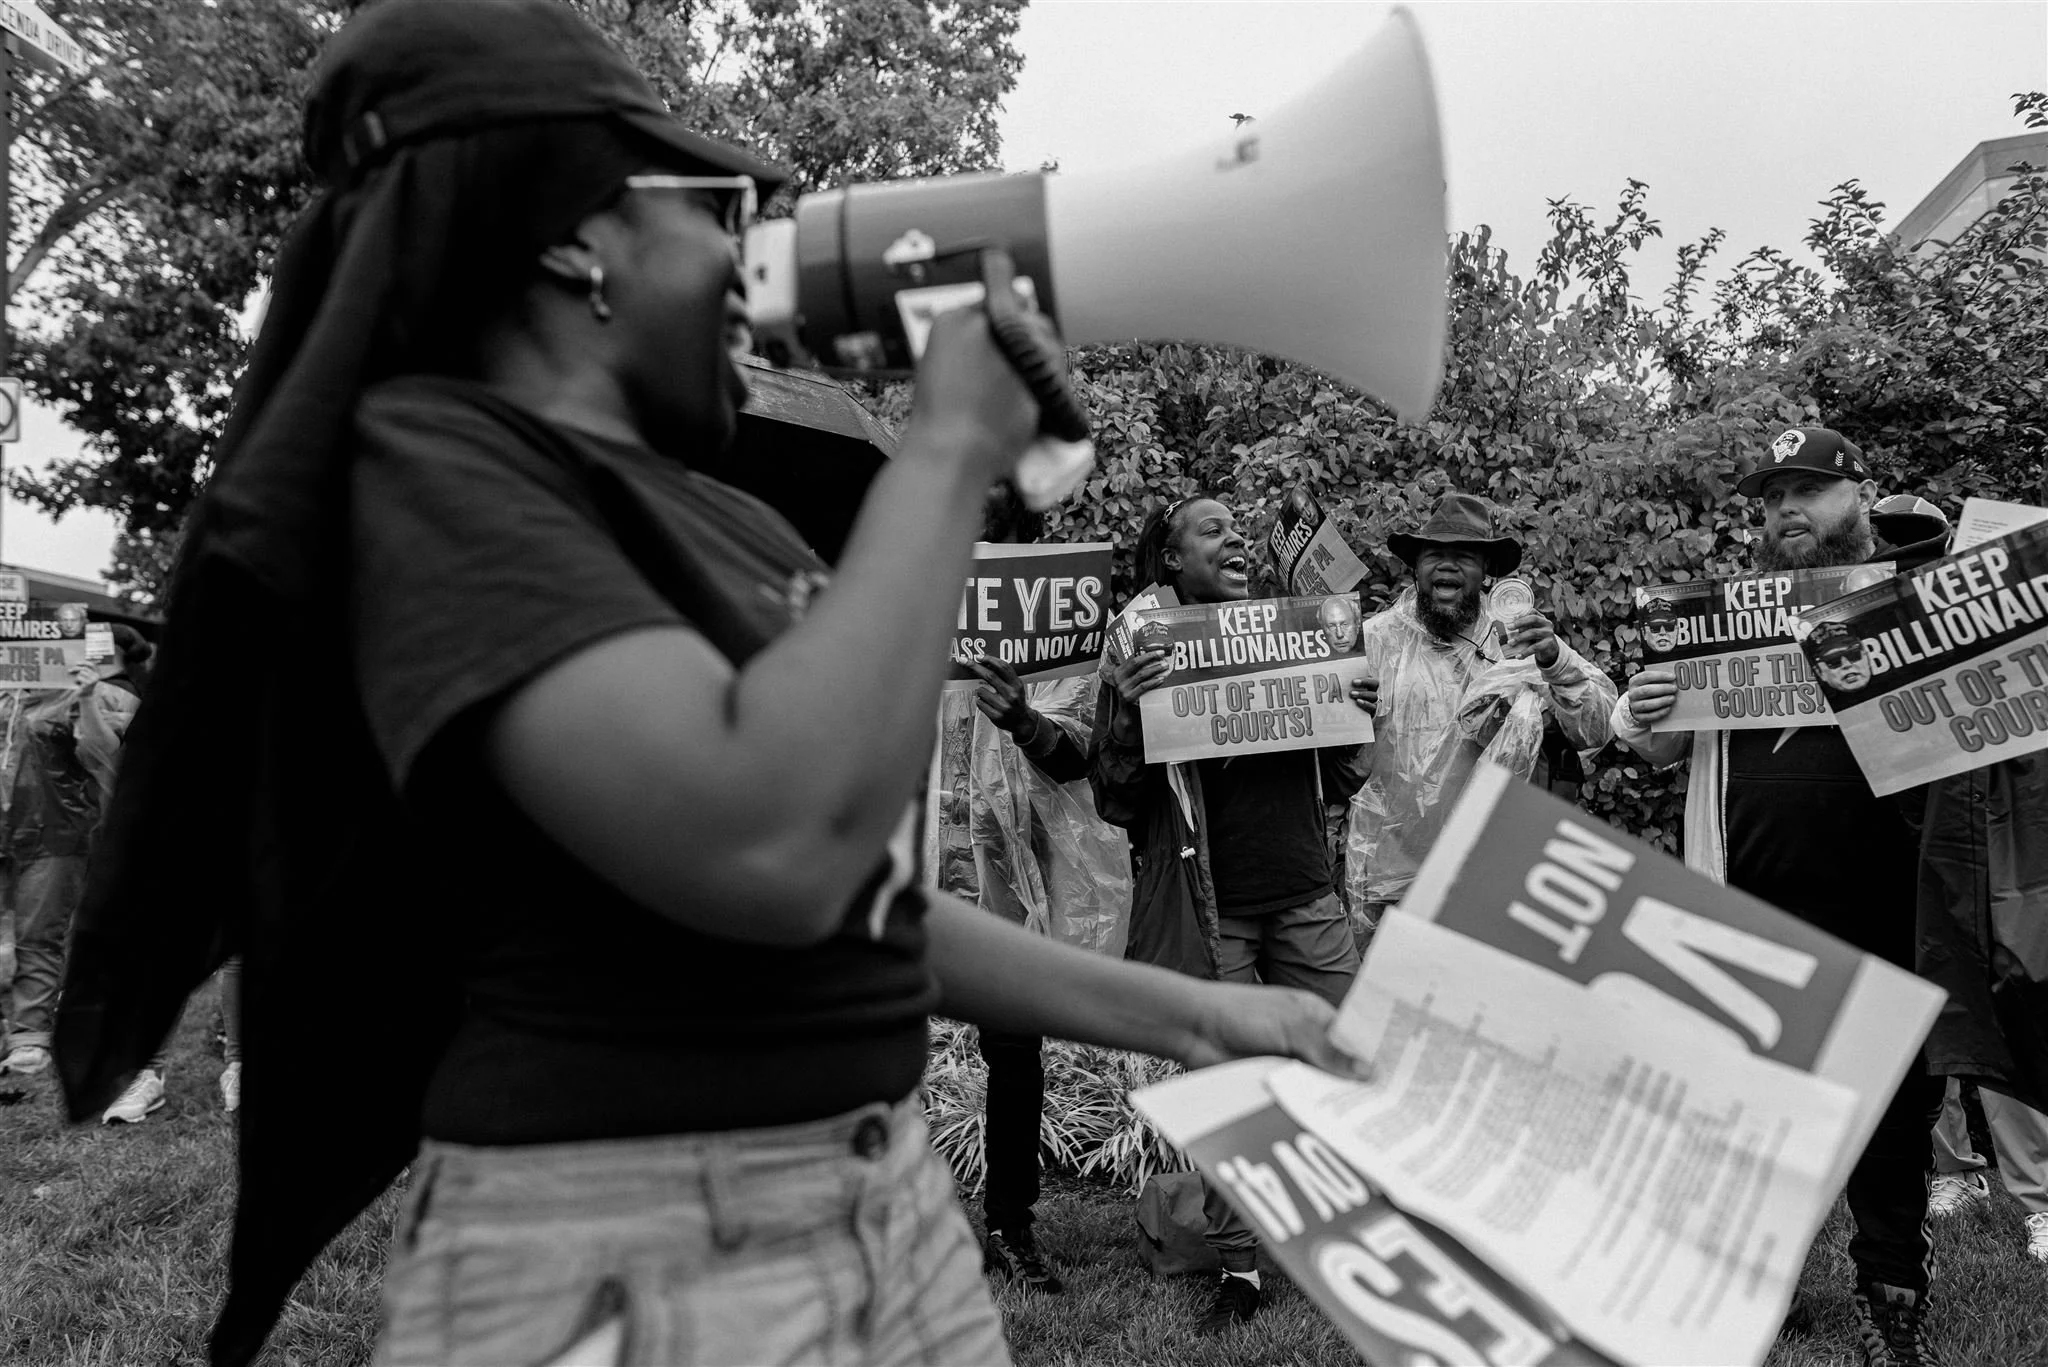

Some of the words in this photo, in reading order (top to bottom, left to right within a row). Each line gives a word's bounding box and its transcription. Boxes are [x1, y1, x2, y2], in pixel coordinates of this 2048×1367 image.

[1297, 557, 1321, 593] THE
[1312, 543, 1335, 571] PA
[1911, 547, 2009, 614] KEEP
[0, 602, 28, 620] EEP
[957, 577, 1002, 631] TE
[1013, 576, 1103, 633] YES
[1724, 576, 1793, 612] KEEP
[0, 620, 62, 639] NAIRES
[1217, 604, 1277, 637] KEEP
[949, 637, 987, 664] ASS
[999, 638, 1029, 664] ON
[1035, 633, 1078, 662] NOV
[1080, 631, 1101, 654] 4!
[1174, 629, 1331, 672] BILLIONAIRES
[1674, 658, 1722, 691] OUT
[1727, 655, 1761, 688] OF
[1171, 683, 1219, 718] OUT
[1225, 680, 1255, 713] OF
[1259, 675, 1310, 709] THE
[1312, 672, 1344, 704] PA
[1712, 683, 1826, 719] COURTS!
[1879, 678, 1954, 733] OUT
[1955, 659, 2007, 707] OF
[1210, 706, 1314, 746] COURTS!
[1949, 690, 2048, 752] COUR
[1506, 817, 1637, 965] NOT
